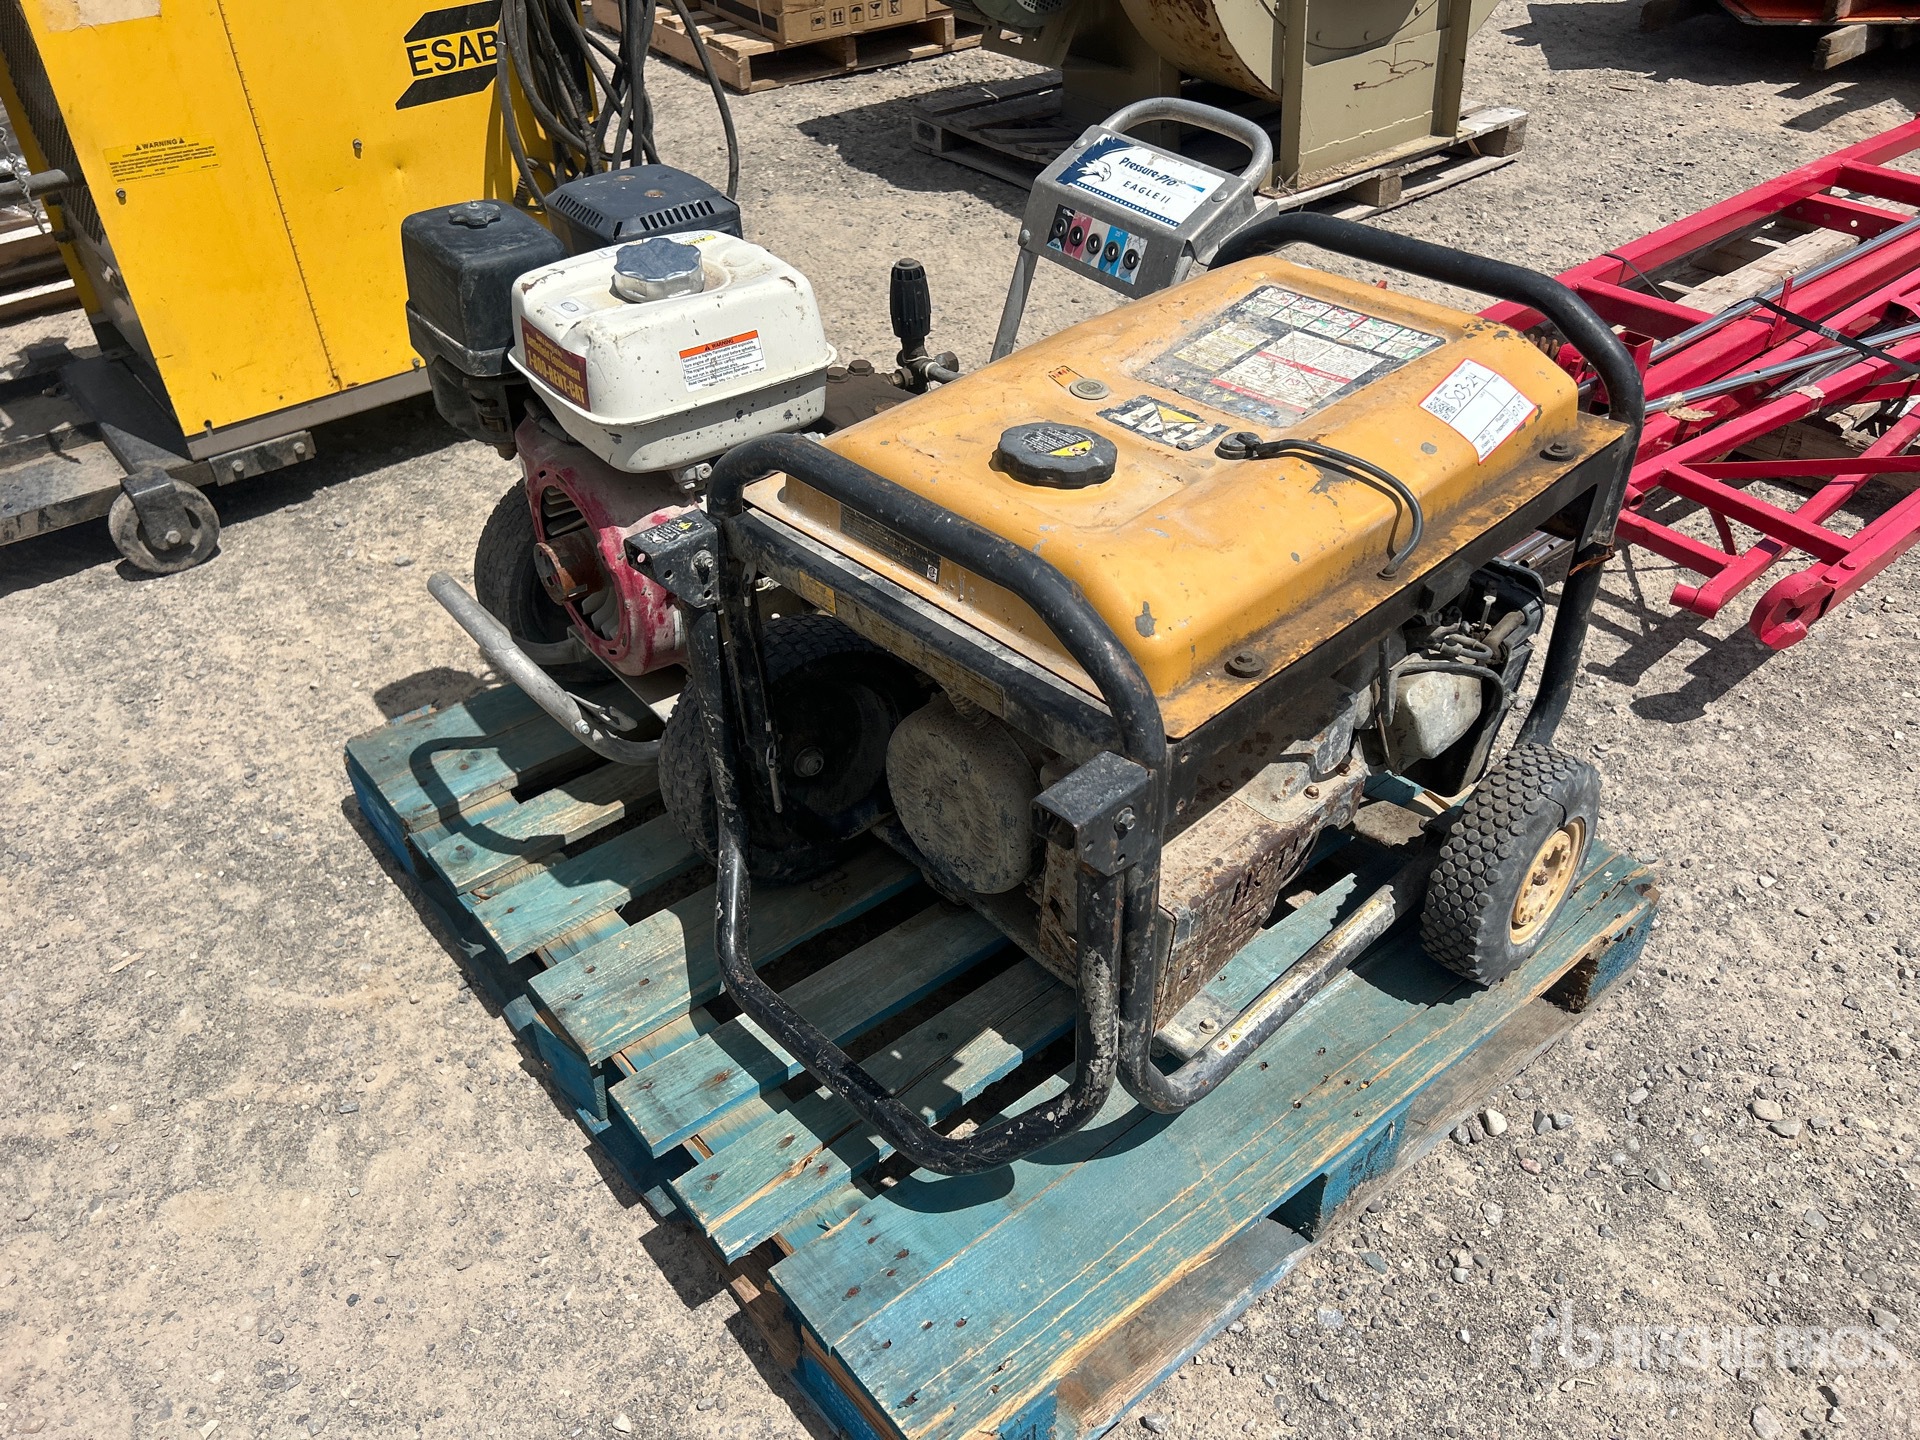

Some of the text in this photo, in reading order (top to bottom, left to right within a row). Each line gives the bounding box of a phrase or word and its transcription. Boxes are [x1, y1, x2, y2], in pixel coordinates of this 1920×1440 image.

[406, 30, 498, 77] ESAB
[142, 138, 178, 150] WARNING
[1122, 180, 1159, 200] EAGLE
[712, 338, 734, 349] WARNING
